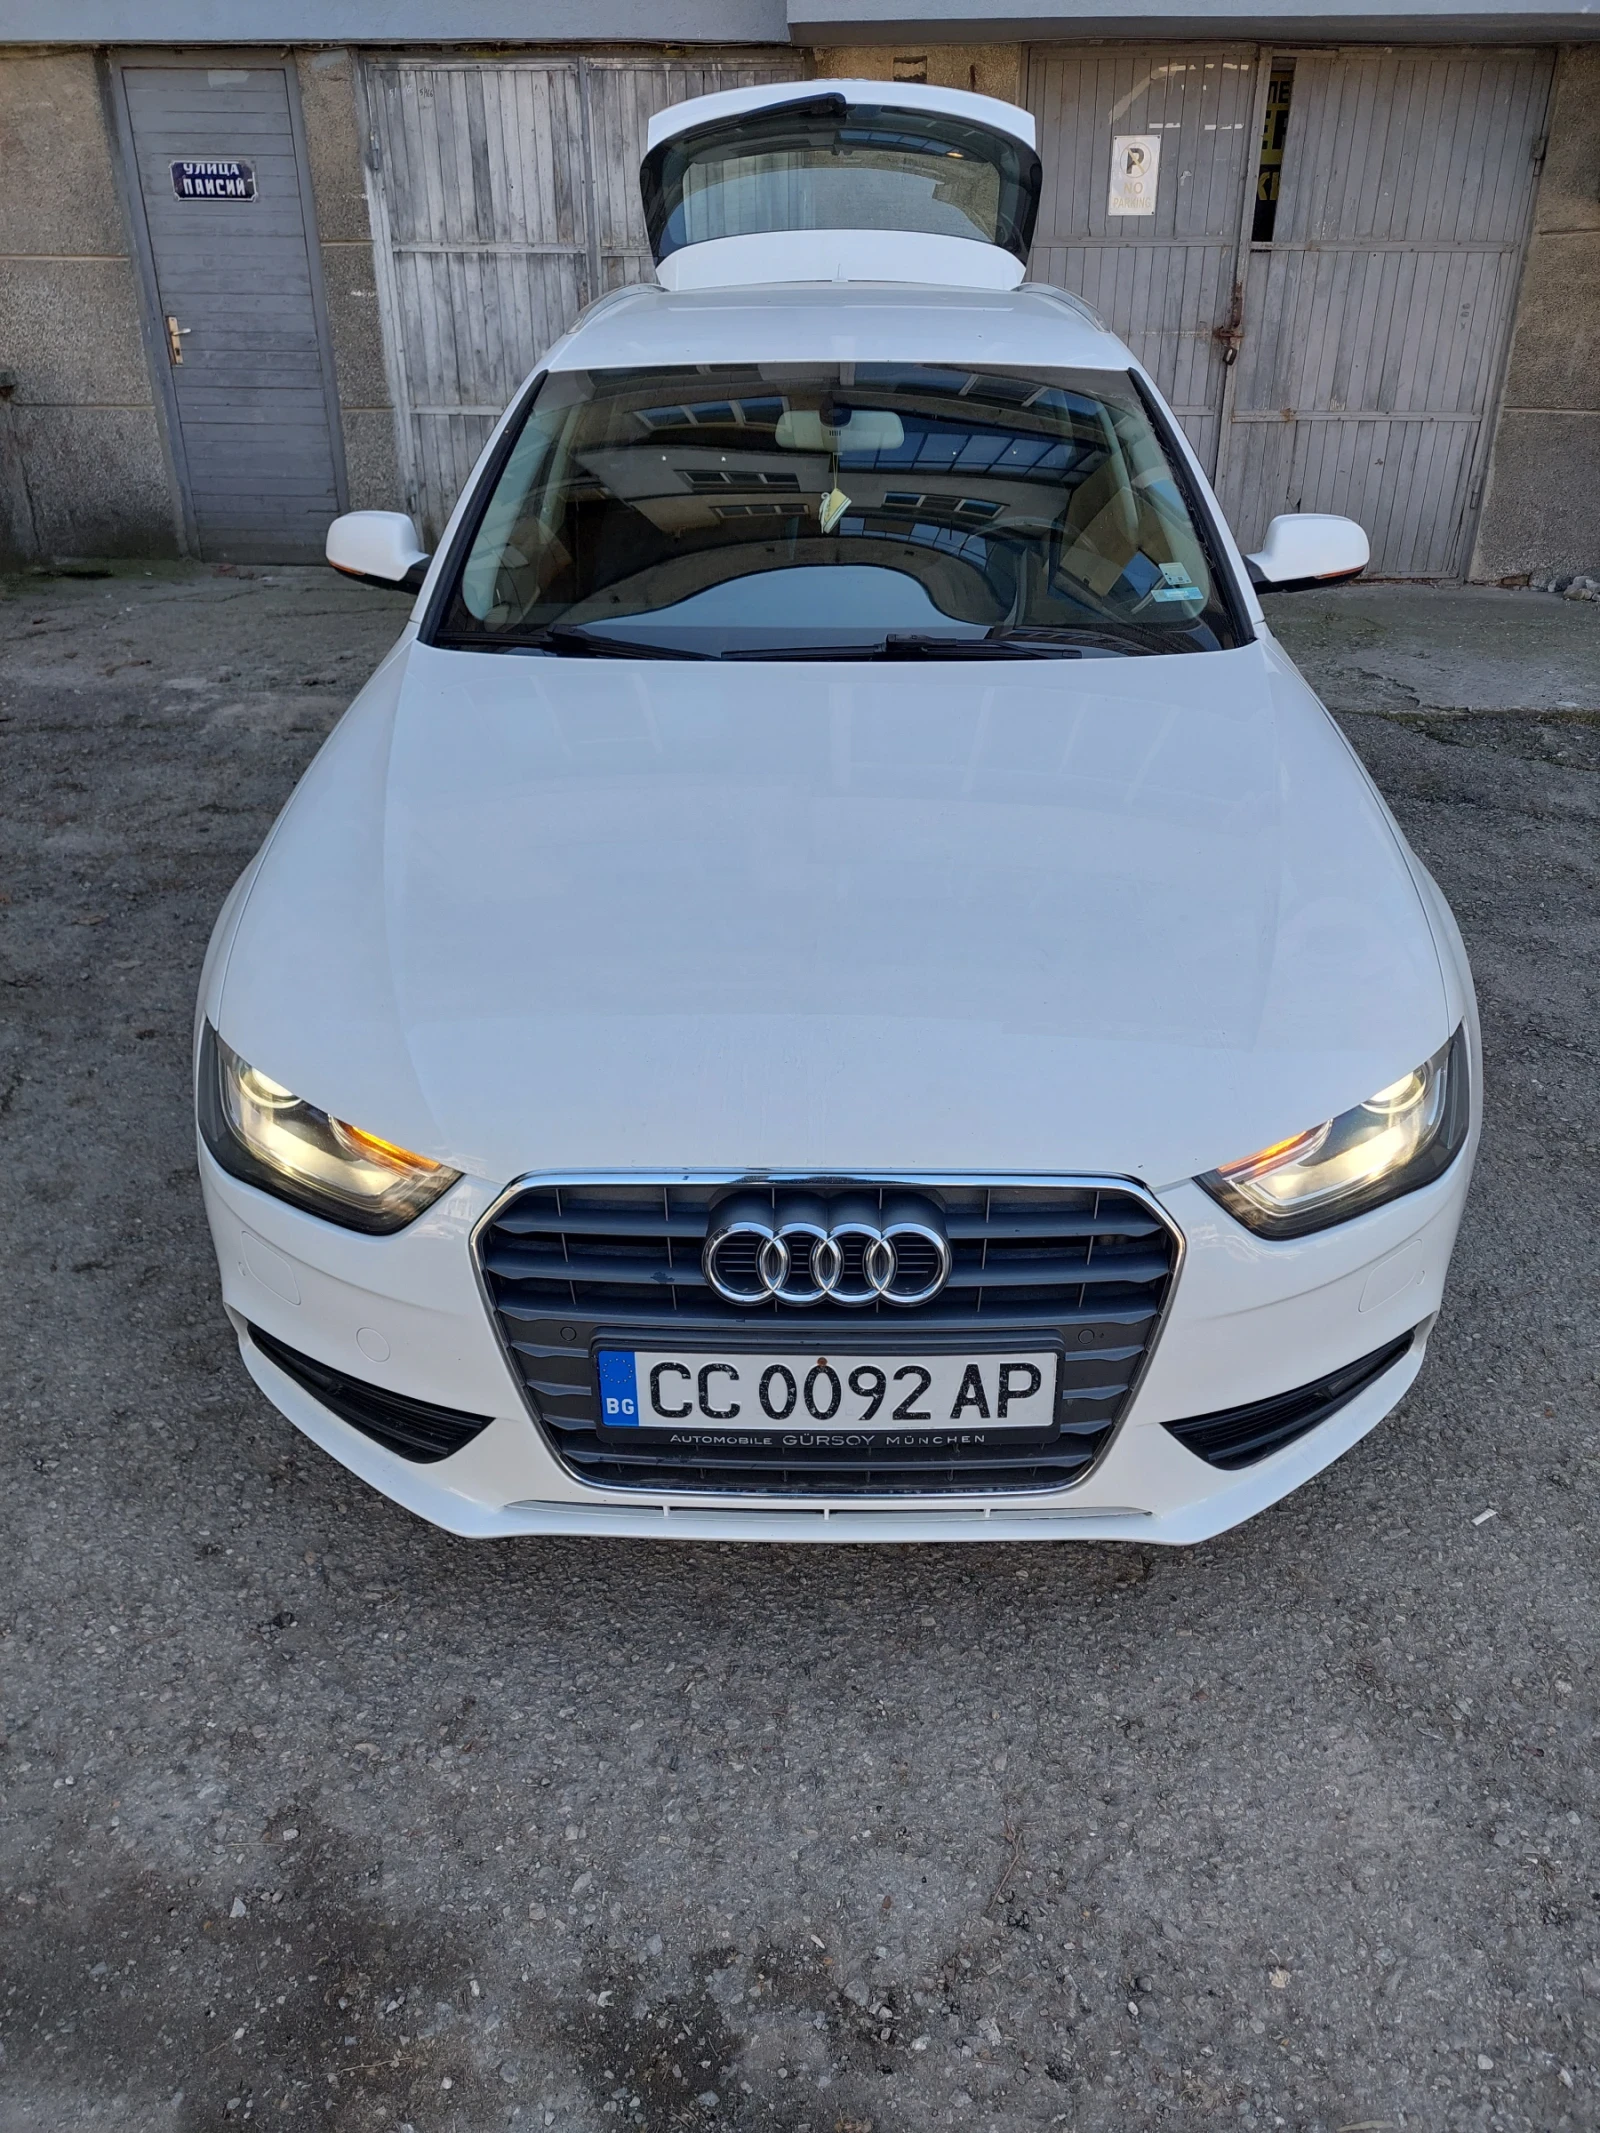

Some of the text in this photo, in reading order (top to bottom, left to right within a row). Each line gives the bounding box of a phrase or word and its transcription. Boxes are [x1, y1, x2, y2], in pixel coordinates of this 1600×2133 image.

[183, 163, 239, 176] УЛИЦА
[183, 177, 246, 196] ПАИСИЙ
[1124, 182, 1144, 194] NO
[1112, 197, 1152, 208] PARKING
[649, 1362, 1042, 1421] CC 0092 AP
[606, 1397, 635, 1415] BG
[782, 1433, 875, 1446] GÜRSOY
[886, 1434, 985, 1445] MÜNCHEN
